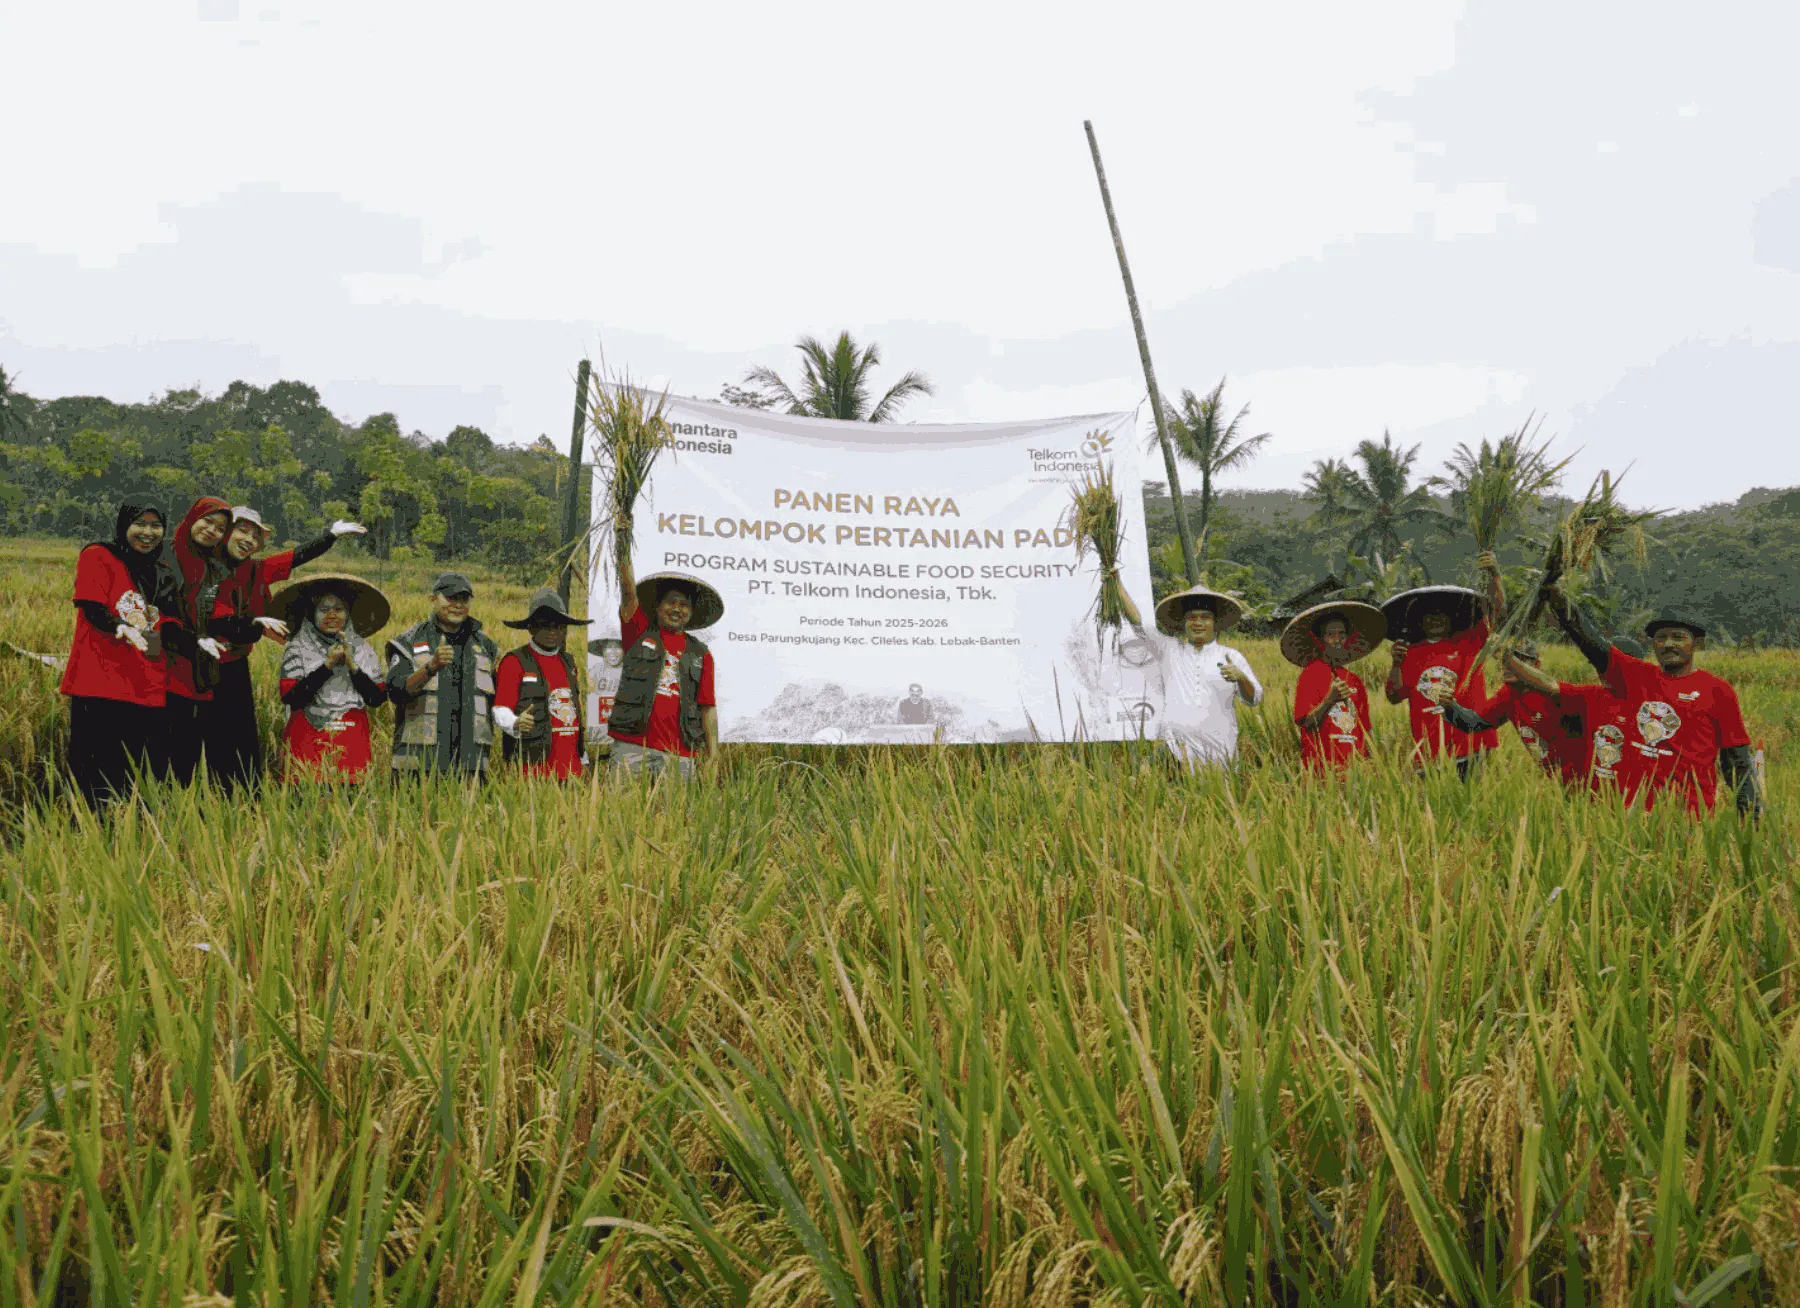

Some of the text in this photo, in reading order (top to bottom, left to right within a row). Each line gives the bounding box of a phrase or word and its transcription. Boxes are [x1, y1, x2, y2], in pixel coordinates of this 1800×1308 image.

[670, 421, 738, 439] nantara
[1027, 448, 1078, 460] Telkom
[1034, 461, 1101, 472] Indonesia
[774, 488, 960, 517] PANEN RAYA
[657, 512, 1074, 549] KELOMPOK PERTANIAN PAD
[664, 551, 1077, 579] PROGRAM SUSTAINABLE FOOD SECURITY
[748, 580, 997, 602] PT. Telkom Indonesia, Tbk.
[799, 616, 948, 628] Periode Tahun 2025-2026
[728, 631, 757, 642] Desa
[760, 632, 840, 646] Parungkujang
[843, 635, 868, 645] Kec.
[912, 636, 936, 646] Kab.
[940, 636, 1020, 646] Lebak-Banten
